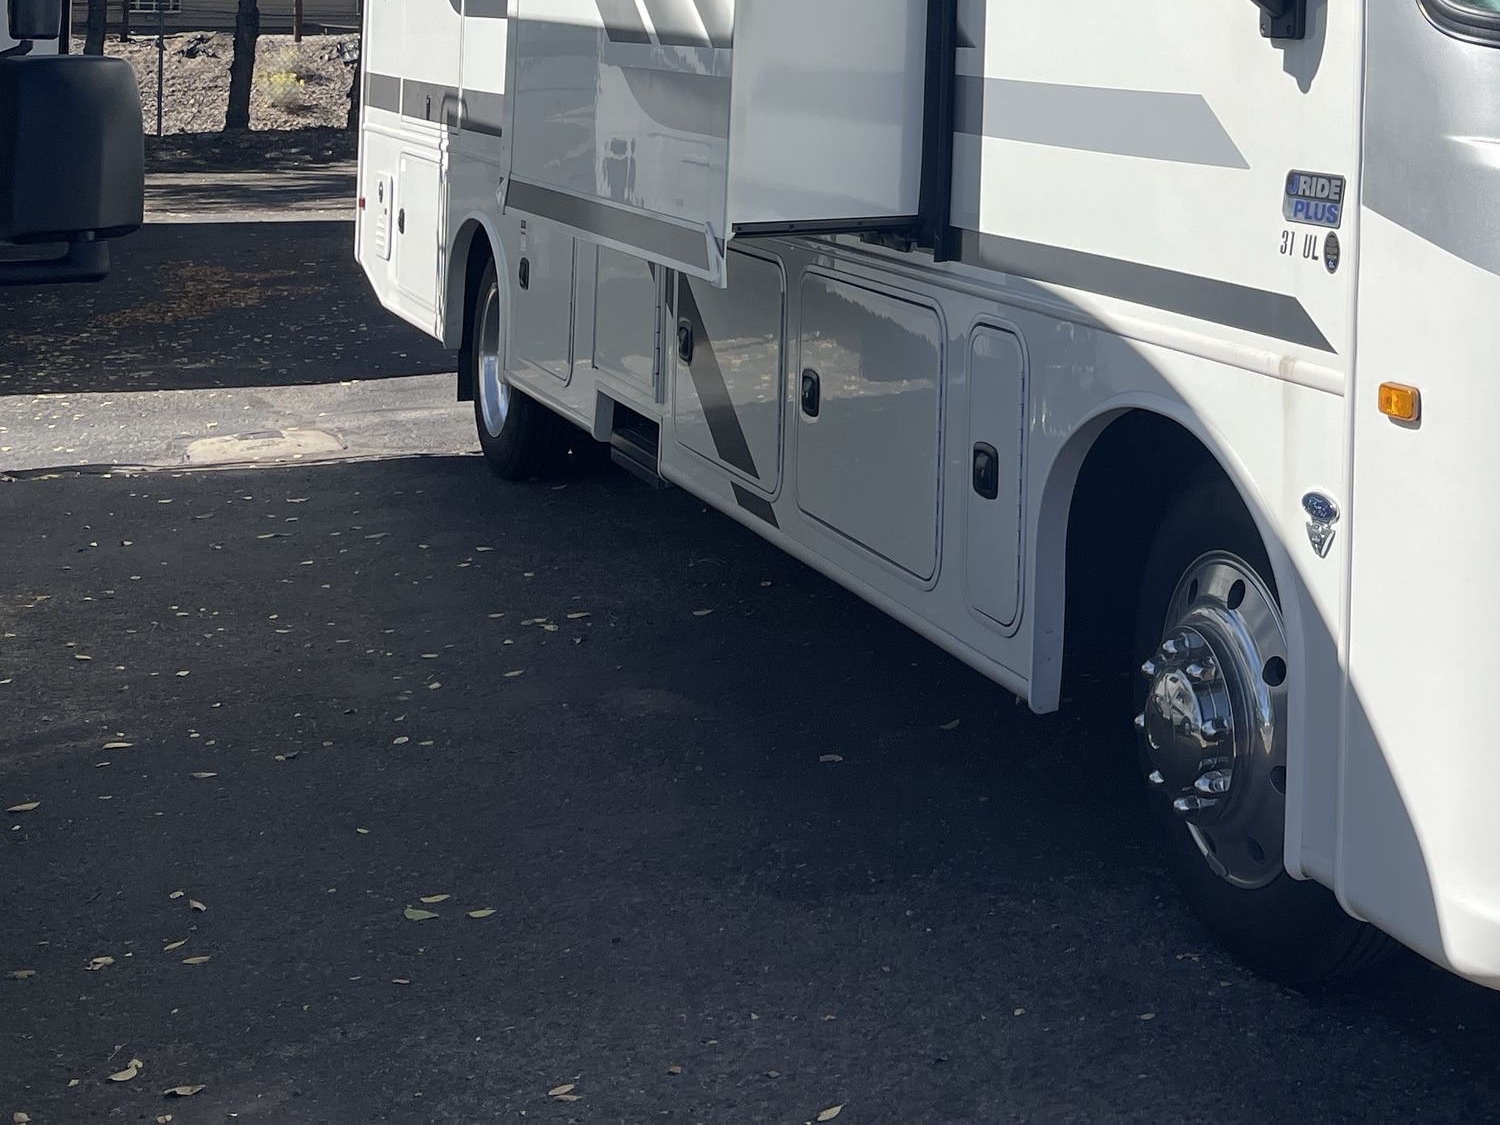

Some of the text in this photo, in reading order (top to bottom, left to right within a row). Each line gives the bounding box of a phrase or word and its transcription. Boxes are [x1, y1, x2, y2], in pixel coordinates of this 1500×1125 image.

[1286, 174, 1341, 201] JRIDE
[1293, 200, 1339, 224] PLUS
[1280, 230, 1295, 256] 31
[1302, 234, 1319, 261] UL
